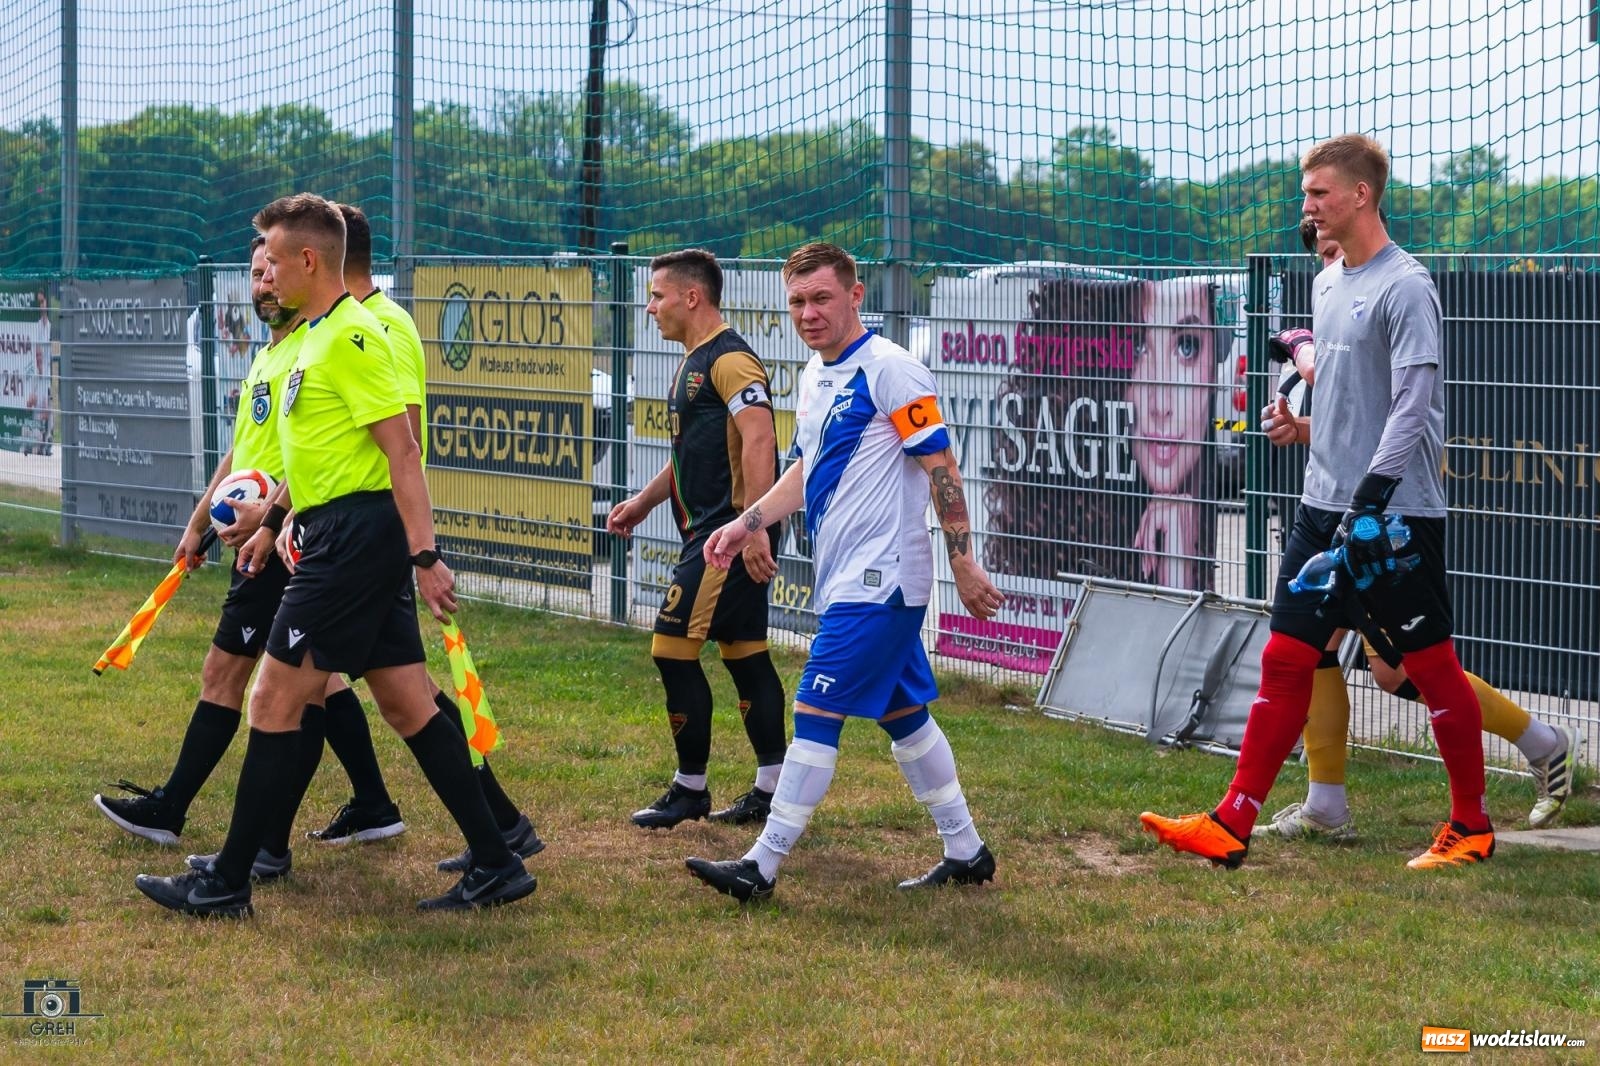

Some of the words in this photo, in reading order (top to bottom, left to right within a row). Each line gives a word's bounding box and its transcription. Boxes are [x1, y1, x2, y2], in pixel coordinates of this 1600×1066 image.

[480, 290, 565, 349] GLOB
[941, 321, 1008, 364] salon
[1015, 321, 1133, 377] fryzjerski
[480, 356, 513, 374] Mateusz
[741, 387, 758, 405] C
[907, 404, 928, 428] C
[432, 404, 578, 468] GEODEZJA
[1440, 435, 1600, 488] CLINI
[433, 508, 470, 529] orzyce
[662, 584, 683, 612] 9
